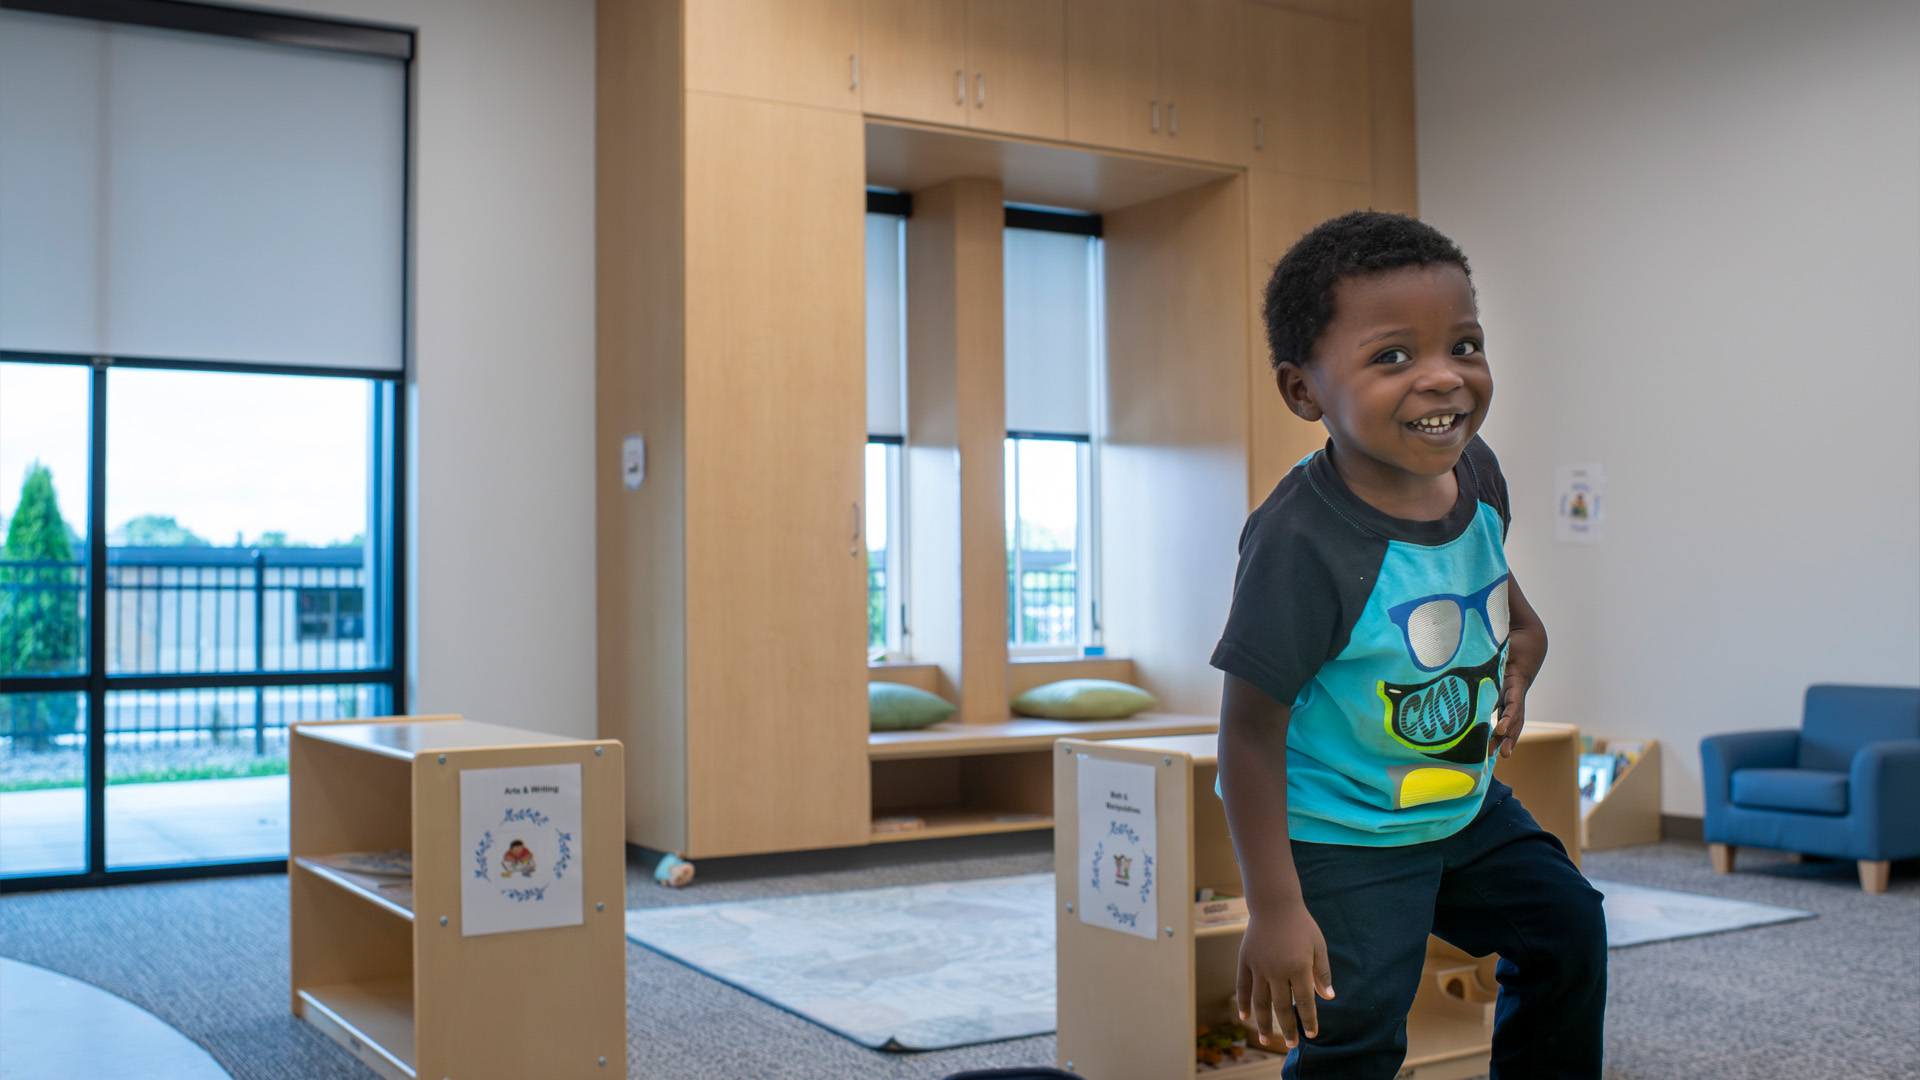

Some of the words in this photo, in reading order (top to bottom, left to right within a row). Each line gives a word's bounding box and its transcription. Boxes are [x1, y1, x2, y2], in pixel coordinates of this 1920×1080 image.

[1401, 676, 1469, 740] COOL
[504, 786, 521, 795] Arts
[531, 785, 559, 795] Writing
